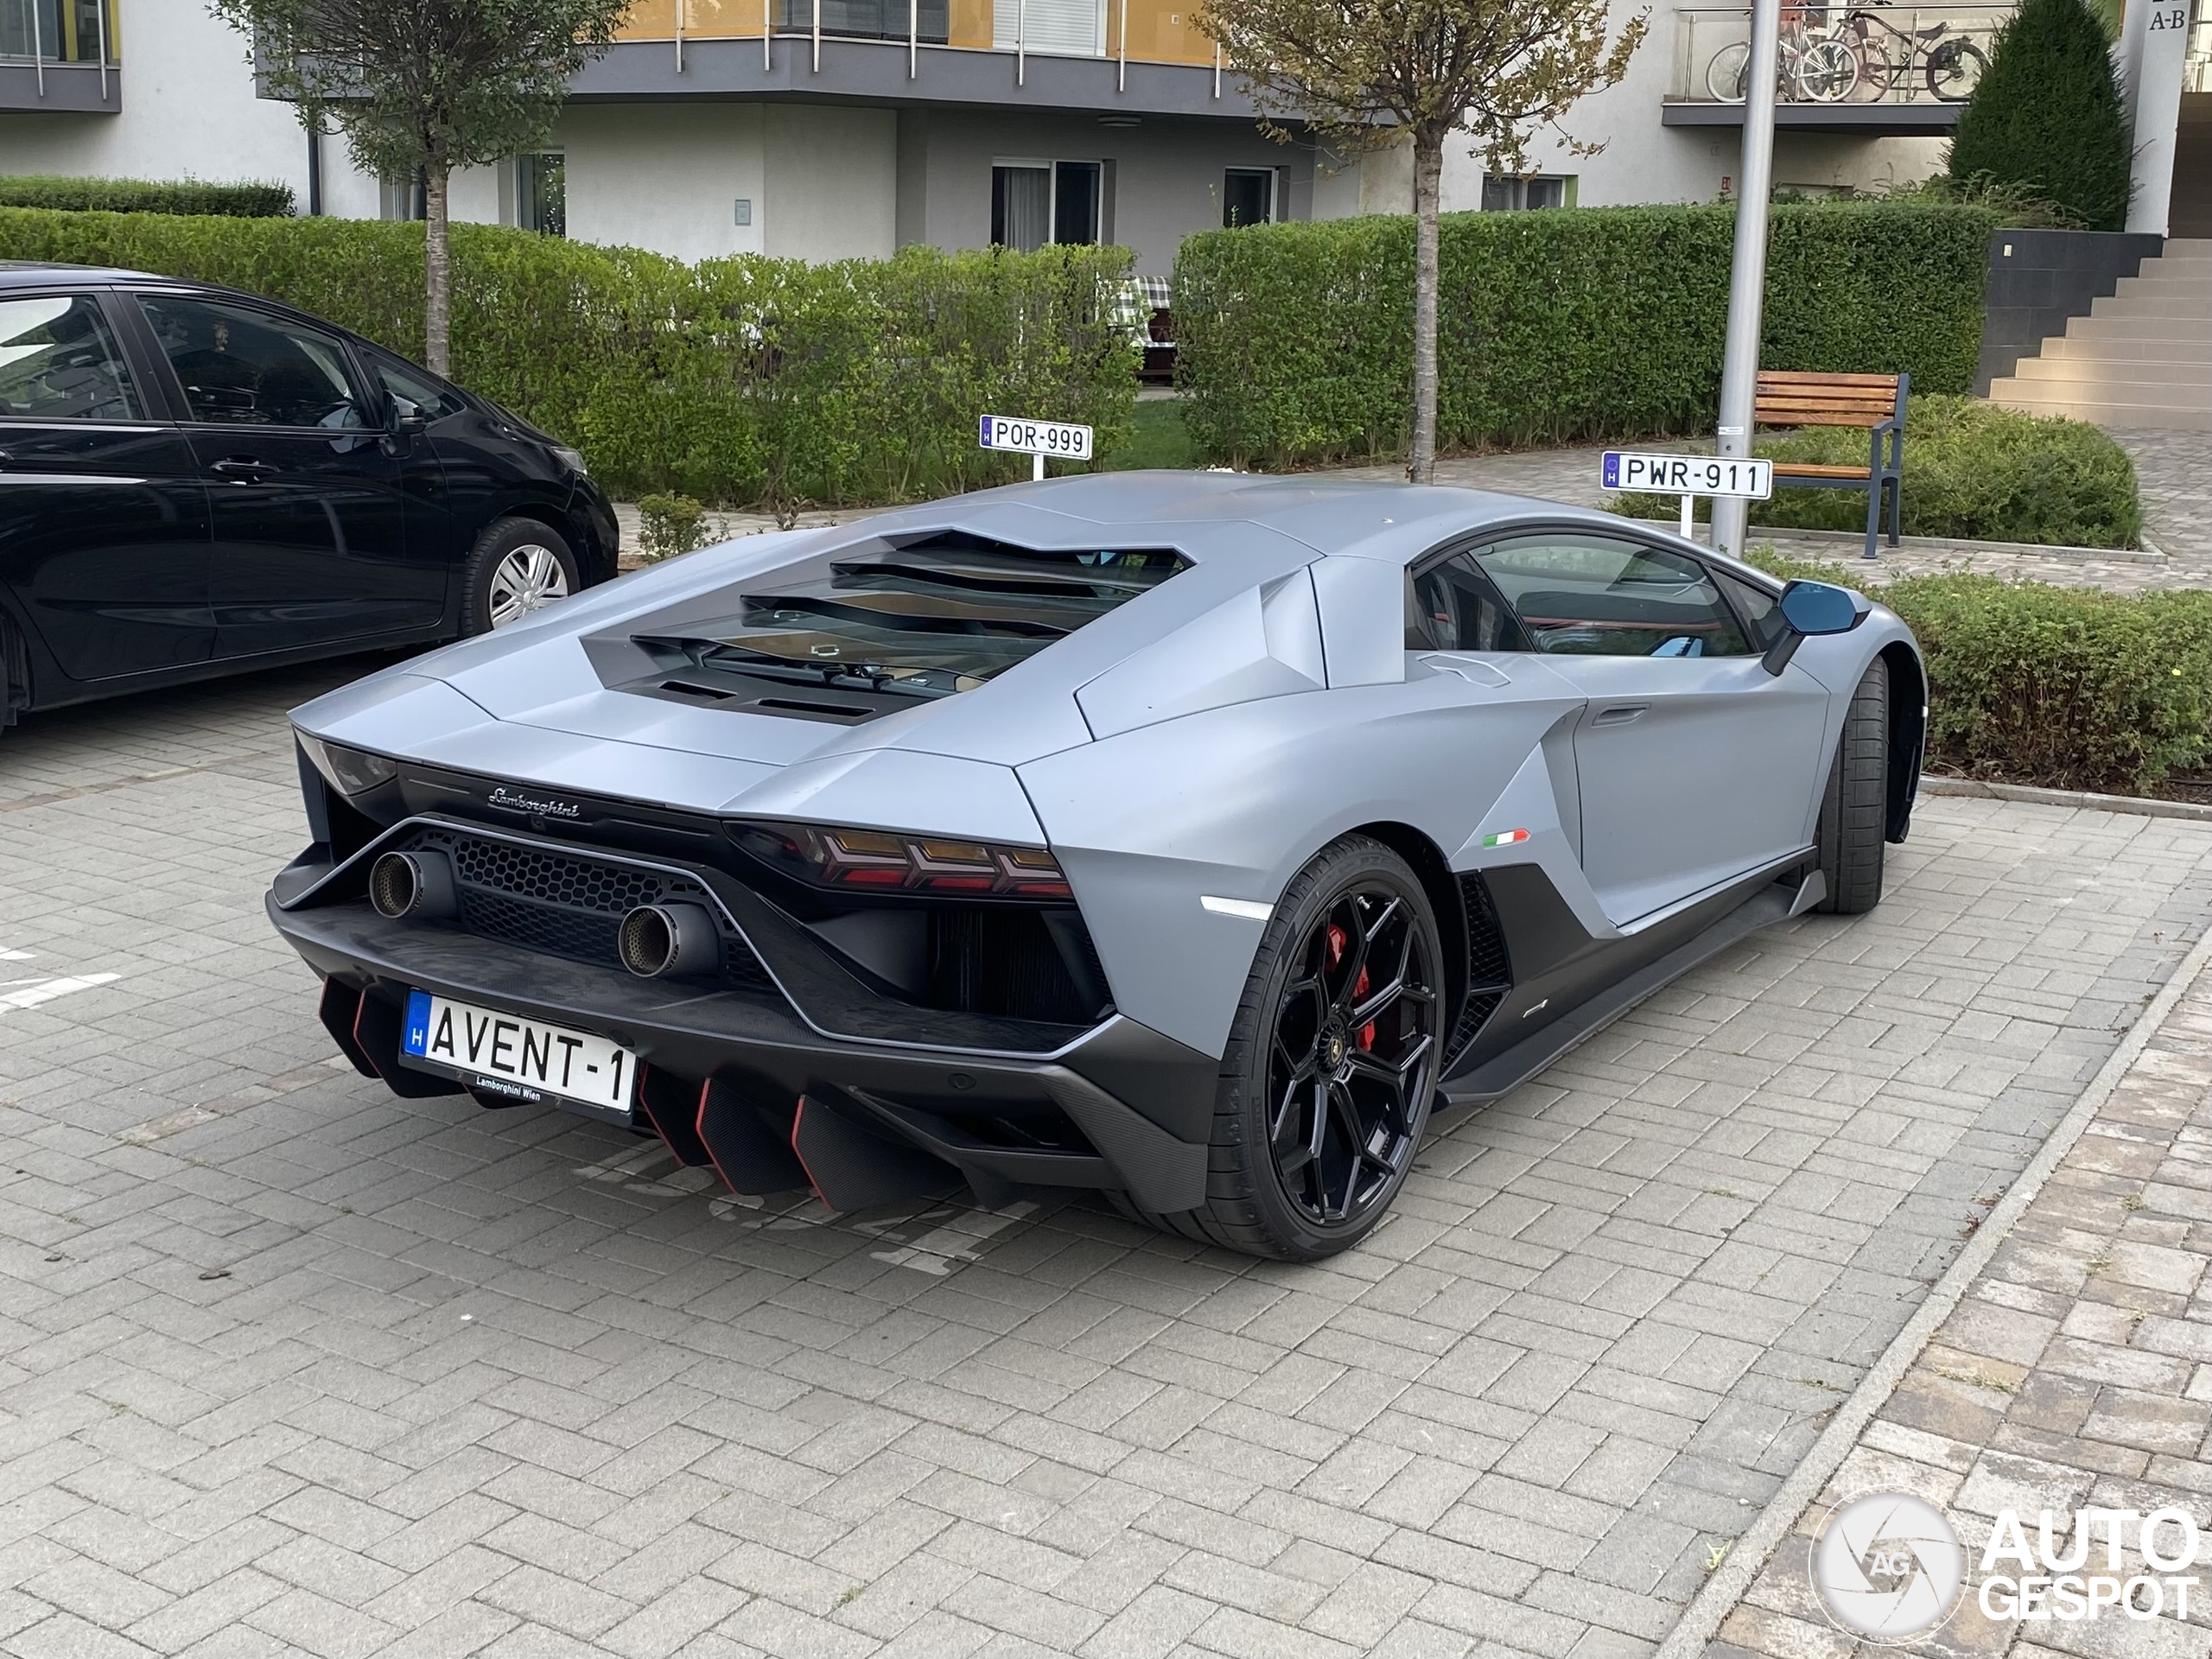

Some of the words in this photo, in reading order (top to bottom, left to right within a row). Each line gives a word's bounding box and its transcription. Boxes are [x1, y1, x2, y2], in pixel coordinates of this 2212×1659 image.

[2149, 10, 2184, 30] A-B
[983, 433, 989, 442] H
[996, 422, 1084, 452] POR-999
[1607, 473, 1616, 483] H
[1627, 459, 1757, 492] PWR-911
[487, 787, 580, 817] Lamborghini
[411, 1027, 423, 1047] H
[431, 1006, 625, 1101] AVENT-1
[476, 1076, 521, 1096] Lamborghini
[523, 1087, 541, 1102] Wien
